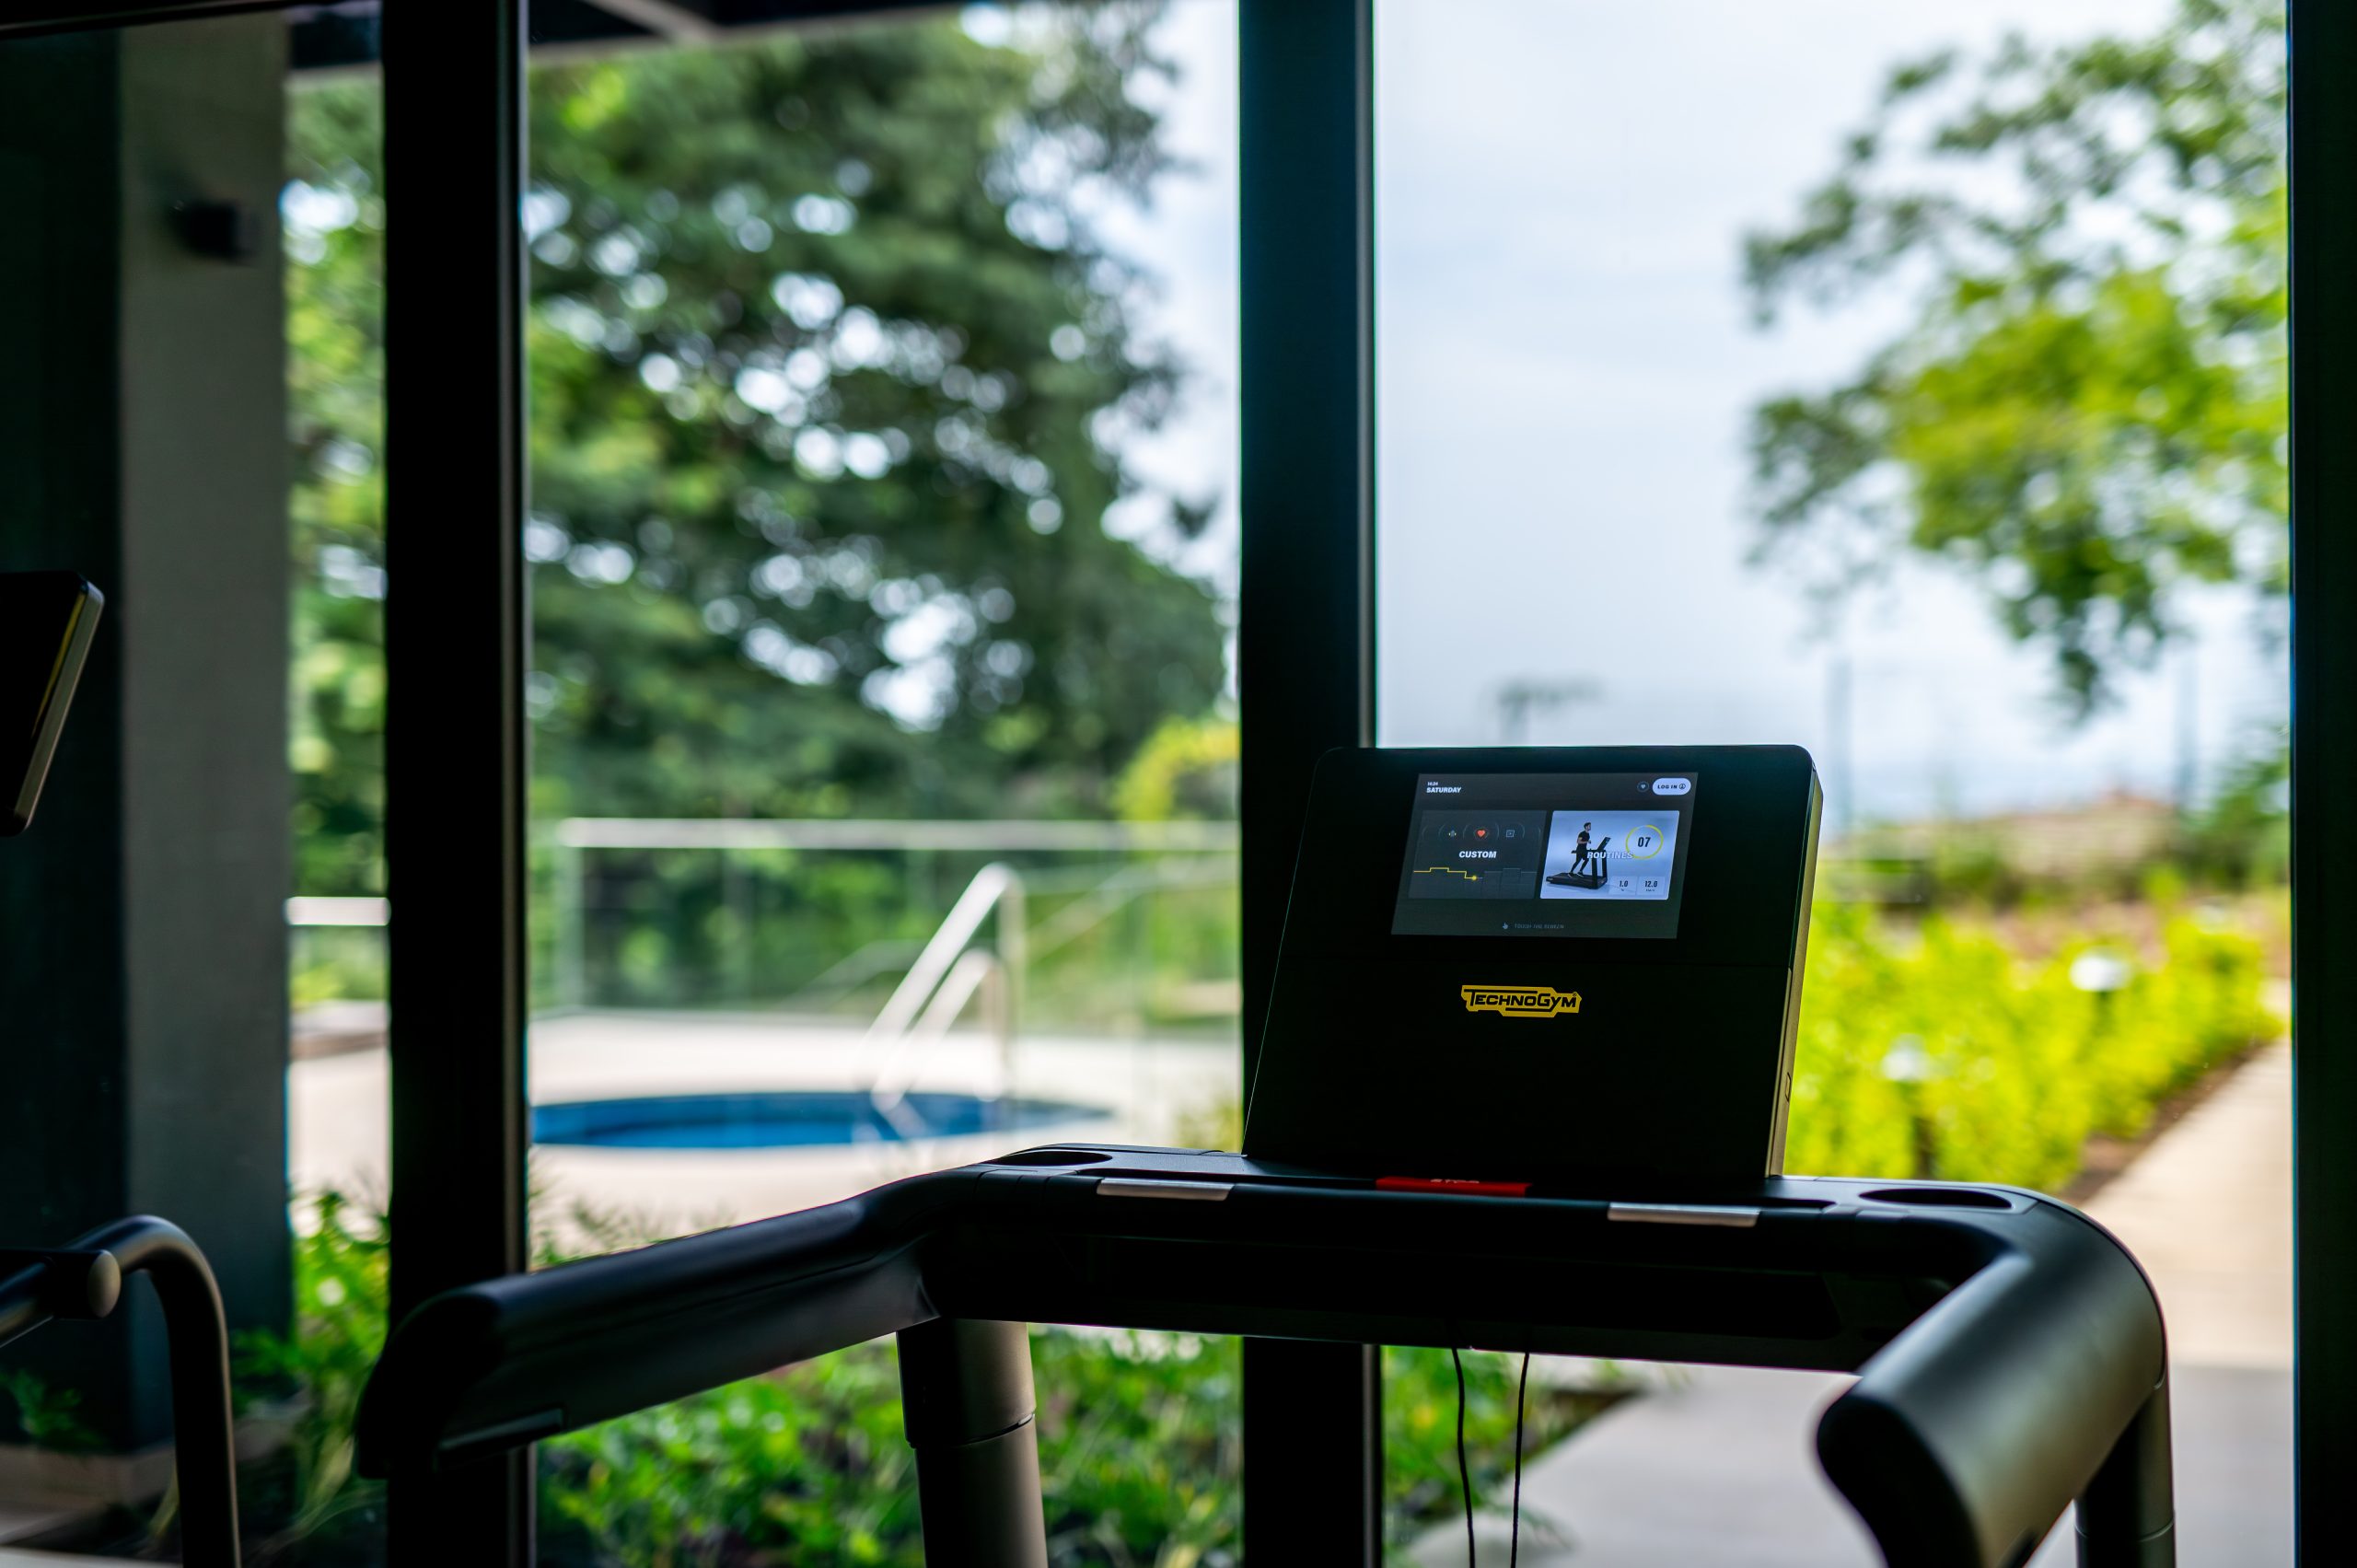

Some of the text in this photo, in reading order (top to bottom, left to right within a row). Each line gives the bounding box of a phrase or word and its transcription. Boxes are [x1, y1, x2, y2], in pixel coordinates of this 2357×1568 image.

[1637, 836, 1651, 848] 07
[1458, 850, 1497, 859] CUSTOM
[1586, 851, 1633, 859] ROUTINES
[1463, 989, 1577, 1013] TECHNOGYM
